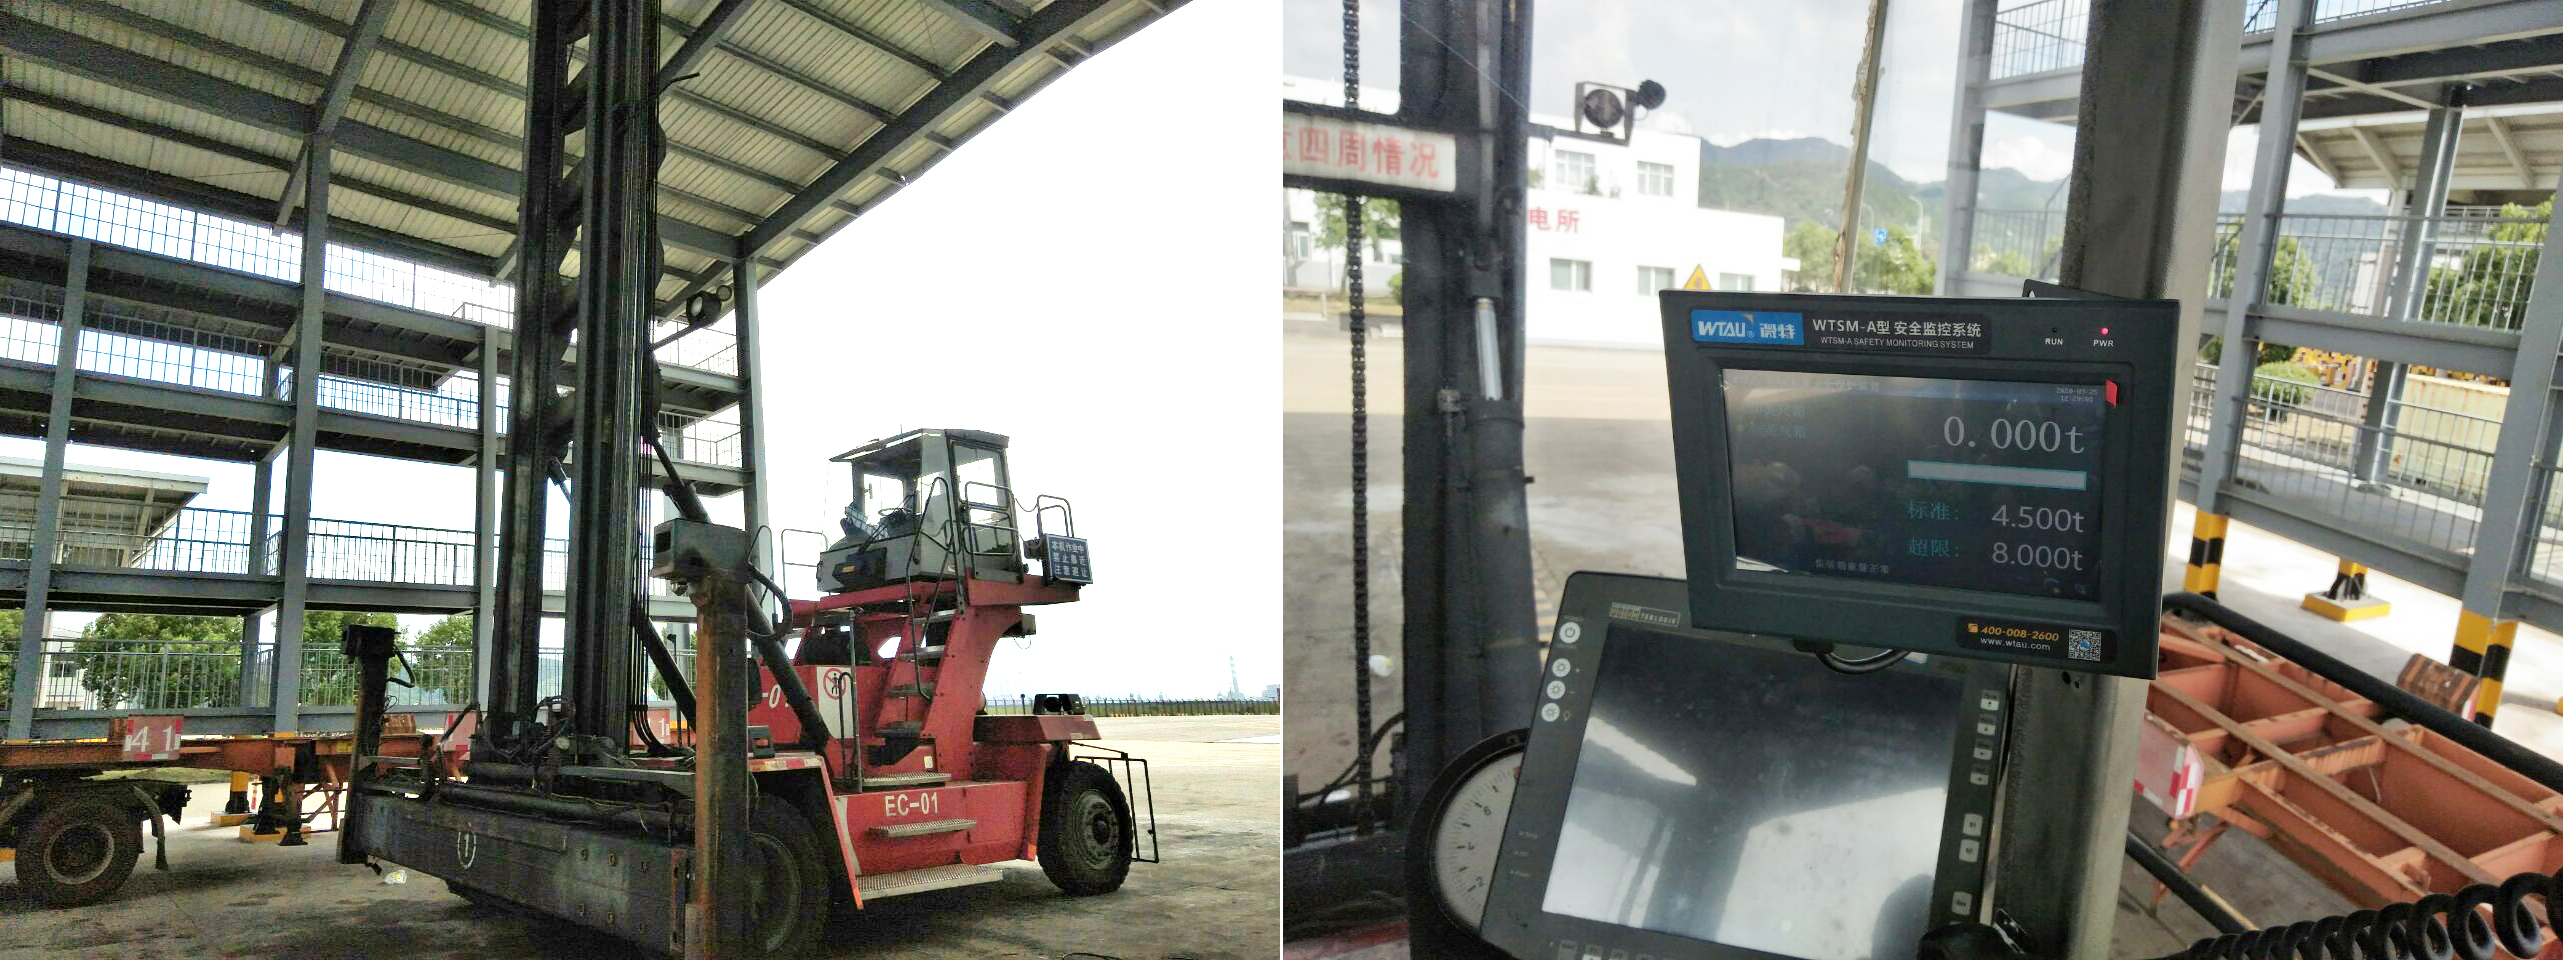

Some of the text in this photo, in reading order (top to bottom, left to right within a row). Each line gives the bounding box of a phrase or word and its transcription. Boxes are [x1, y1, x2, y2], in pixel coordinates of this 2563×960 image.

[1698, 320, 1747, 338] WTAU
[1812, 319, 1982, 338] WTSM-A型 安全监控系统
[1820, 336, 1974, 350] WTSM-A SAFETY MONITORING SYSTEM
[2045, 338, 2064, 346] RUN
[1991, 504, 2084, 533] 4.500t
[1992, 542, 2083, 571] 8.000t
[1980, 625, 2060, 641] 400-008-2600
[1980, 637, 2051, 650] www.wtau.com
[884, 792, 938, 817] EC-01
